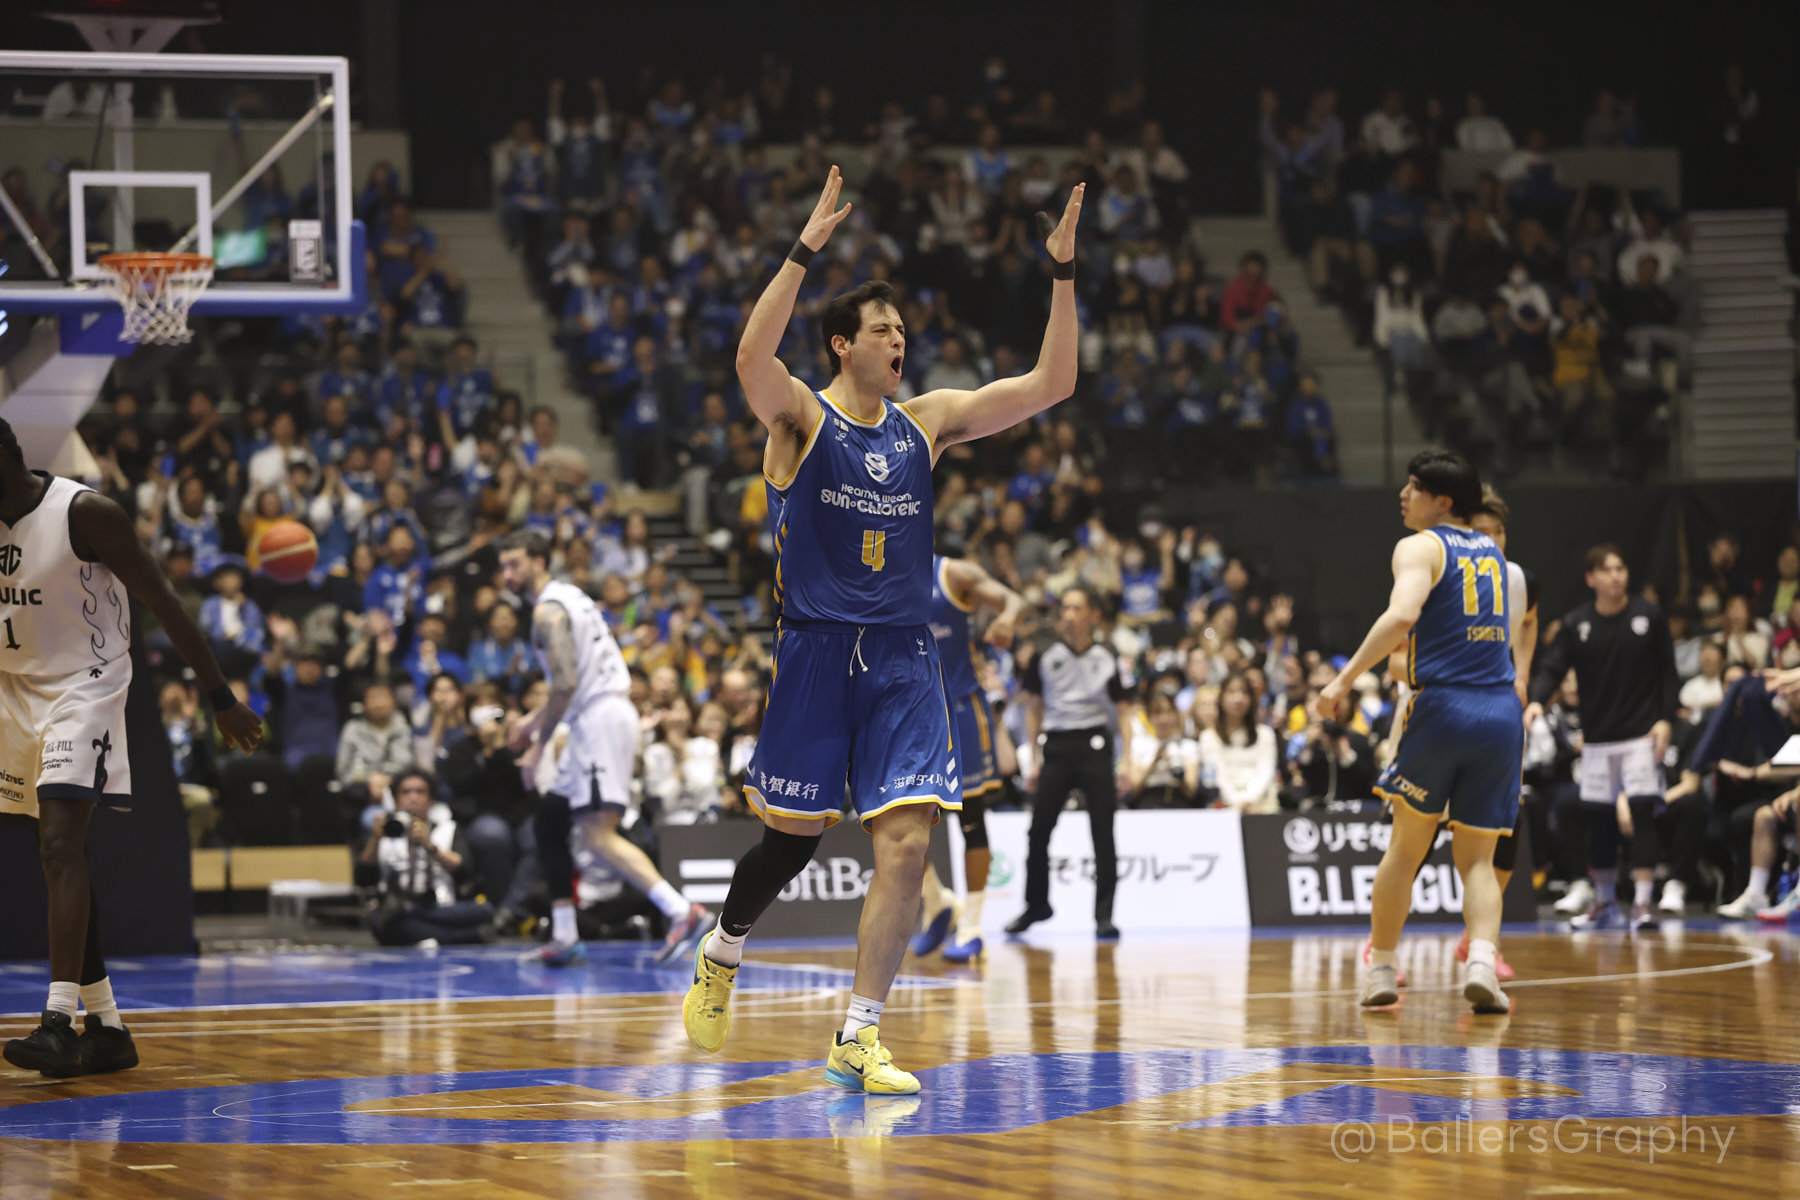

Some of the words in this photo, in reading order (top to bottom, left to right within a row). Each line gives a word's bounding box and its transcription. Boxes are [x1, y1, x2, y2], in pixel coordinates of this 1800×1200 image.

[861, 530, 885, 572] 4
[0, 587, 43, 606] ULIC
[1457, 555, 1503, 616] 17
[3, 617, 22, 650] 1
[1049, 853, 1219, 884] そなグループ
[1287, 864, 1465, 916] B.LEGU
